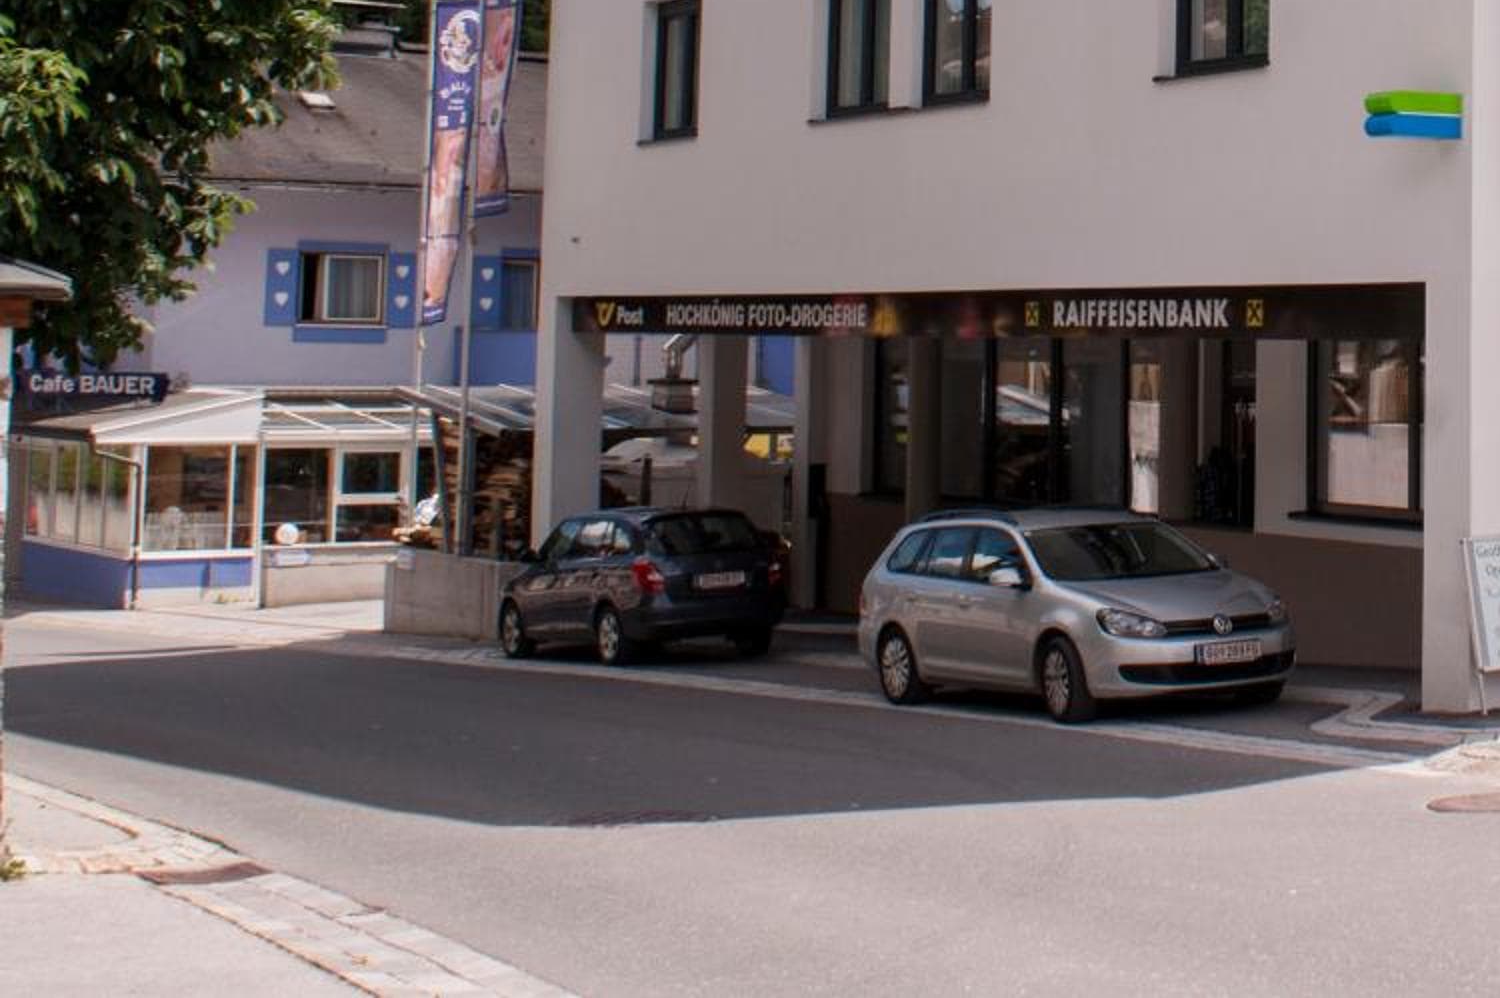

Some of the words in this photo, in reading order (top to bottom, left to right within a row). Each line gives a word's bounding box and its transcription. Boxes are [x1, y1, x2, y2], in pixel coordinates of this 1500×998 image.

[616, 304, 644, 324] Post
[666, 300, 744, 326] HOCHKÖNIG
[748, 303, 866, 328] FOTO-DROGERIE
[1052, 298, 1228, 328] RAIFFEISENBANK
[30, 374, 74, 393] Cafe
[79, 375, 155, 395] BAUER
